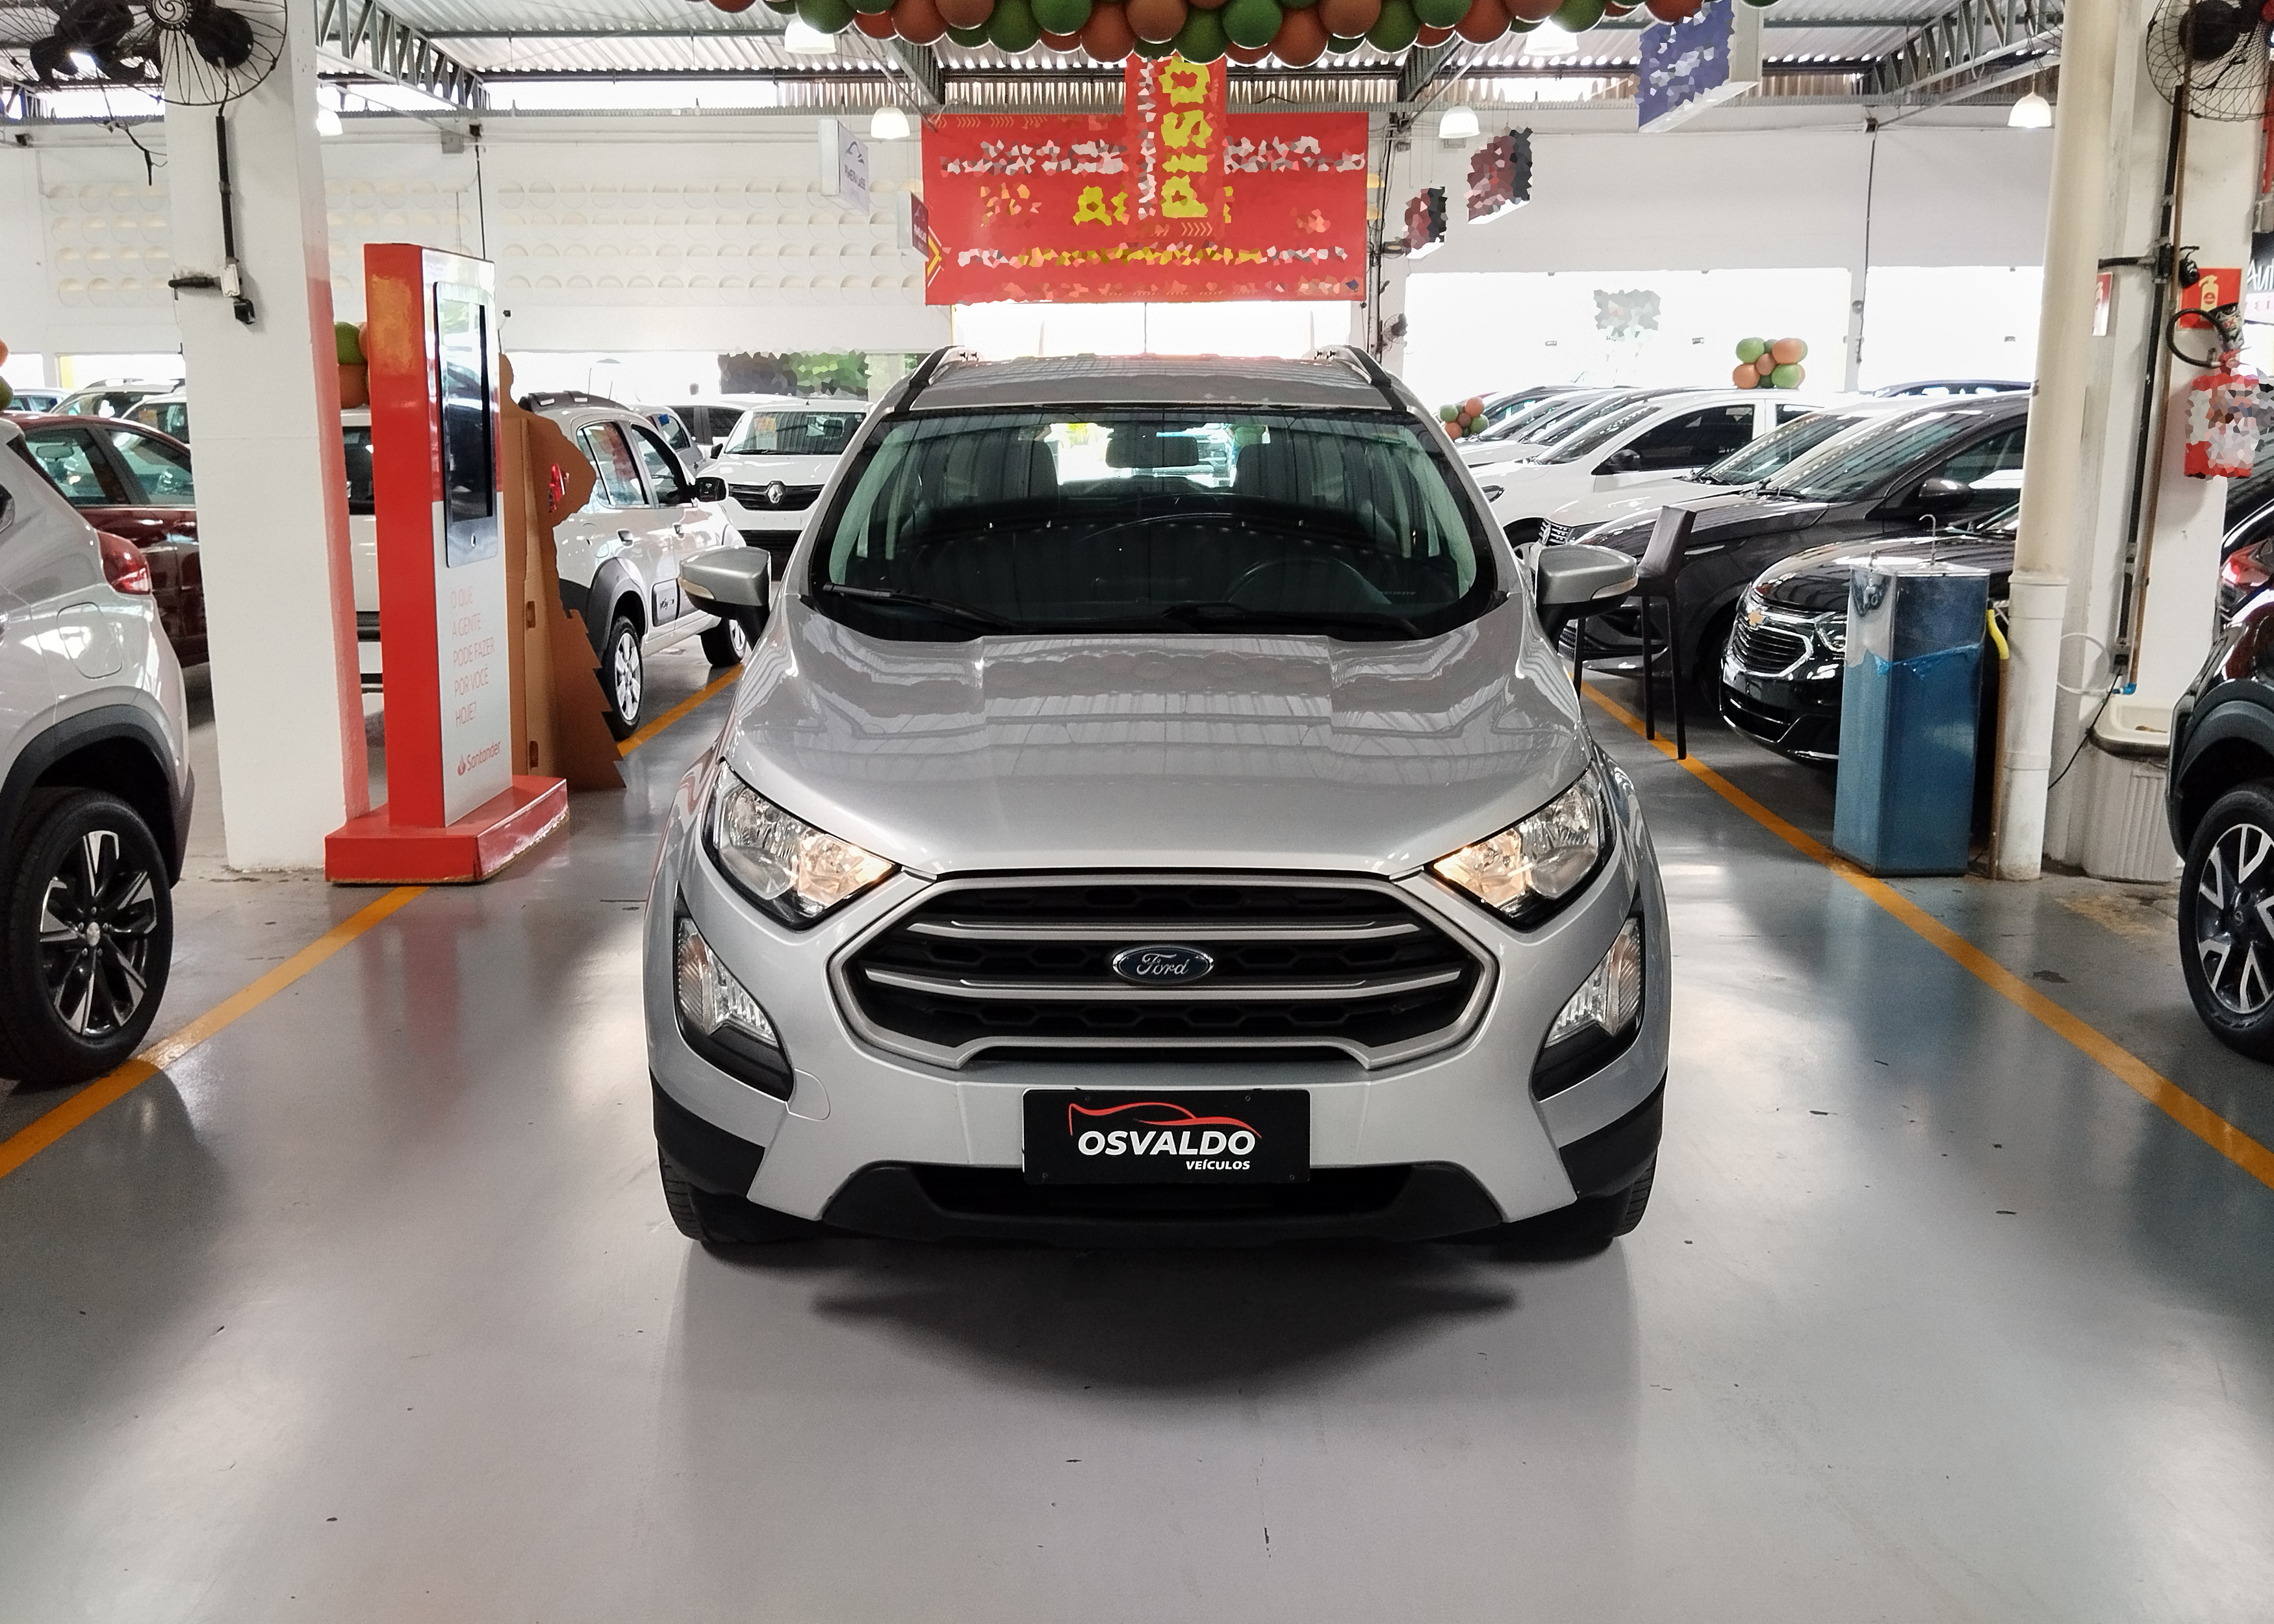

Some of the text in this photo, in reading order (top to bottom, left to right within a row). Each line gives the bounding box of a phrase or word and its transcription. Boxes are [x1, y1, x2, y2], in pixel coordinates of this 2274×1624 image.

[451, 586, 473, 609] O QUE
[452, 612, 481, 640] A GENTE
[453, 636, 494, 668] PODE FAZER
[454, 676, 469, 698] POR
[455, 702, 477, 727] HOJE?
[466, 741, 501, 771] Santander
[1136, 952, 1190, 975] Ford
[1078, 1130, 1256, 1156] OSVALDO
[1186, 1159, 1251, 1170] VEÍCULOS
